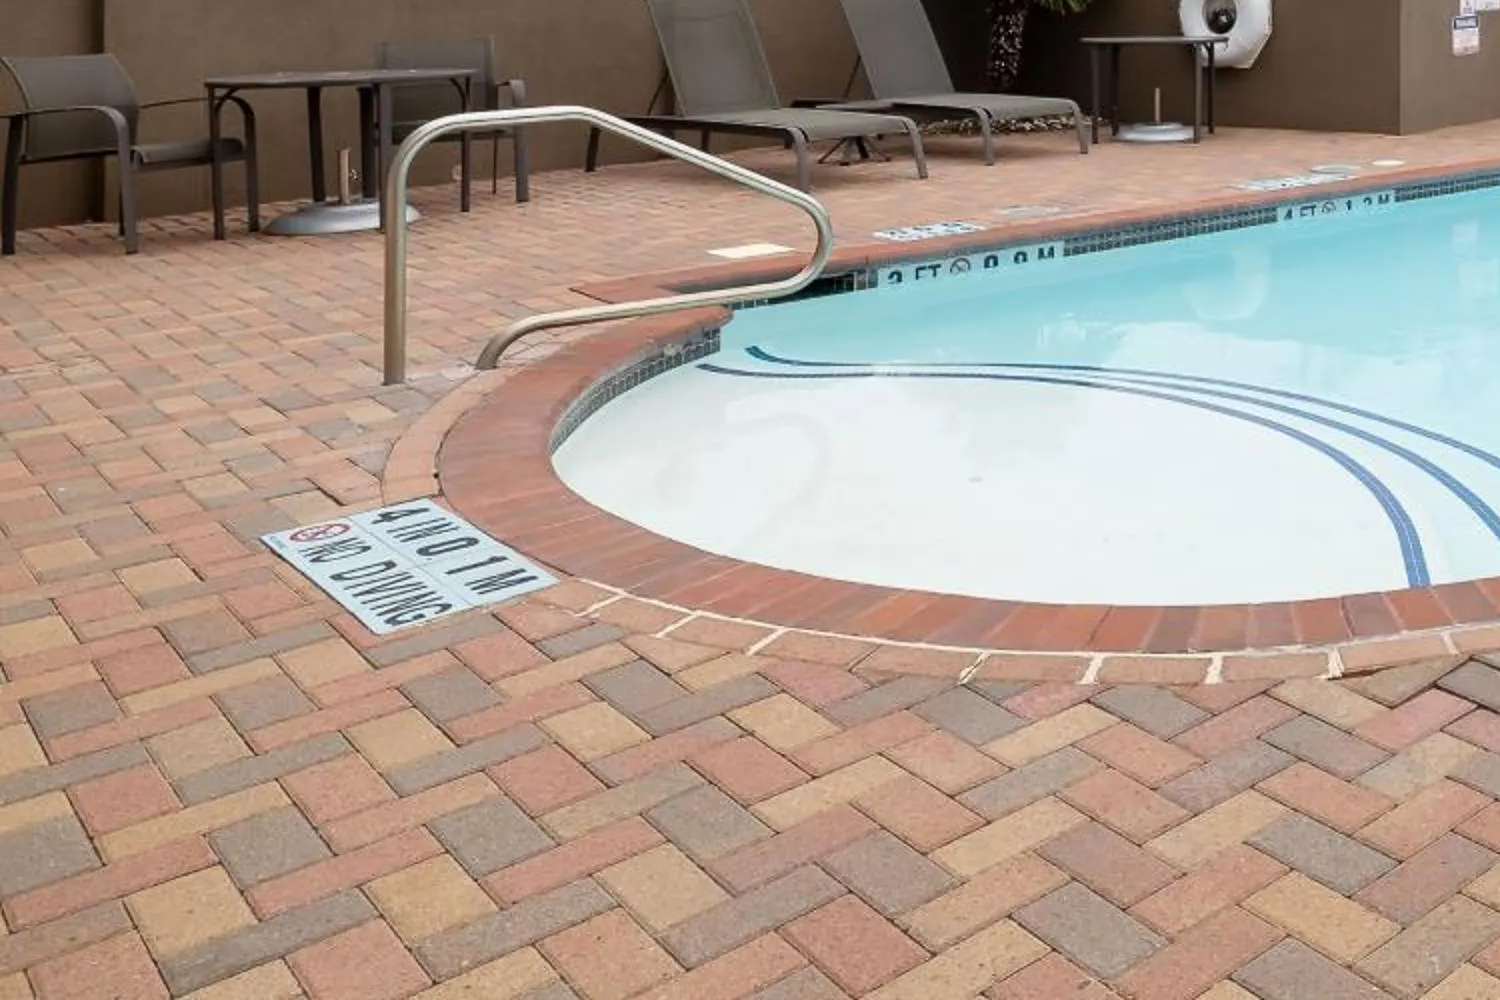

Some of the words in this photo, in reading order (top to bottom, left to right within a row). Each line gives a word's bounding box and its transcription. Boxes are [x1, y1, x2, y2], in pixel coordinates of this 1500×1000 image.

[915, 264, 941, 280] FT
[372, 508, 430, 524] 4
[299, 537, 372, 563] NO
[329, 559, 453, 626] DIVING
